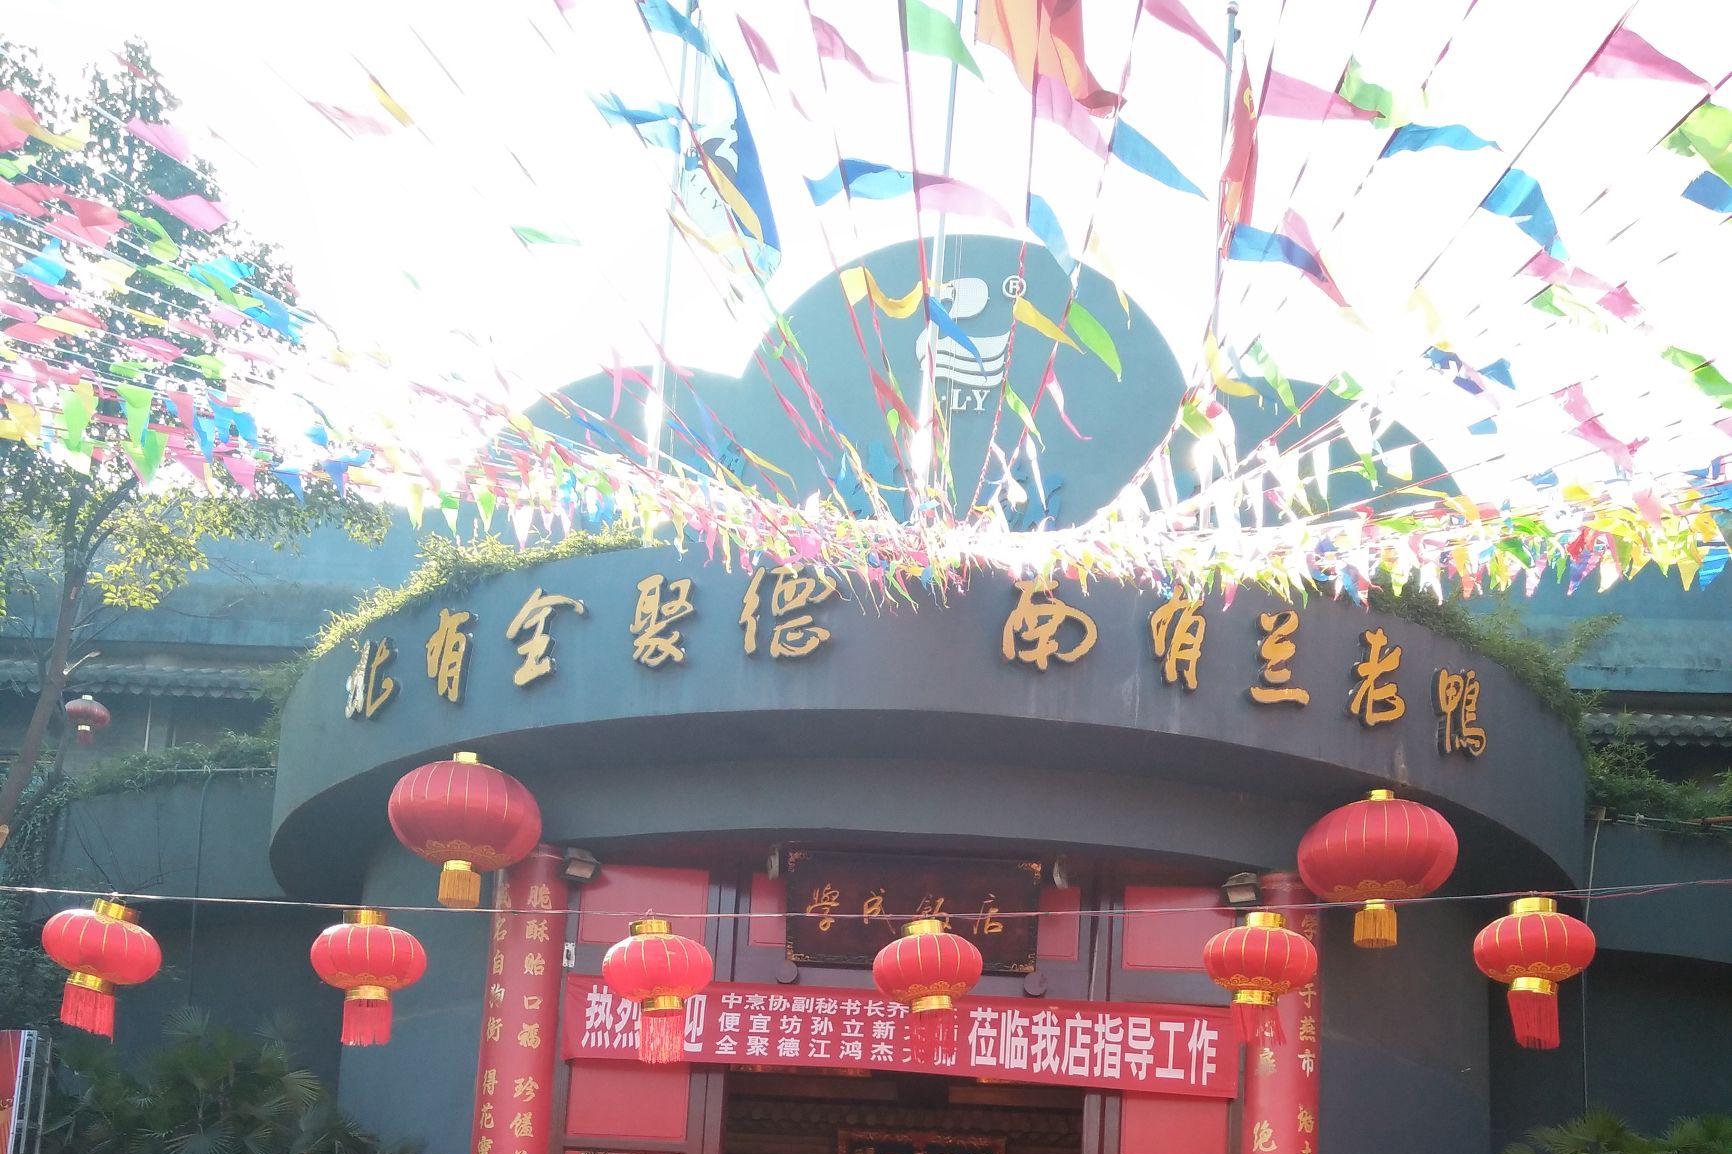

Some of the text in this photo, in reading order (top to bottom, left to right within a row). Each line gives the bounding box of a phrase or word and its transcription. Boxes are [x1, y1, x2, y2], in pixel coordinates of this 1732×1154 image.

[345, 564, 838, 719] 北有全聚德
[581, 984, 707, 1053] 热烈迎
[968, 1006, 1219, 1086] 莅临我店指导工作
